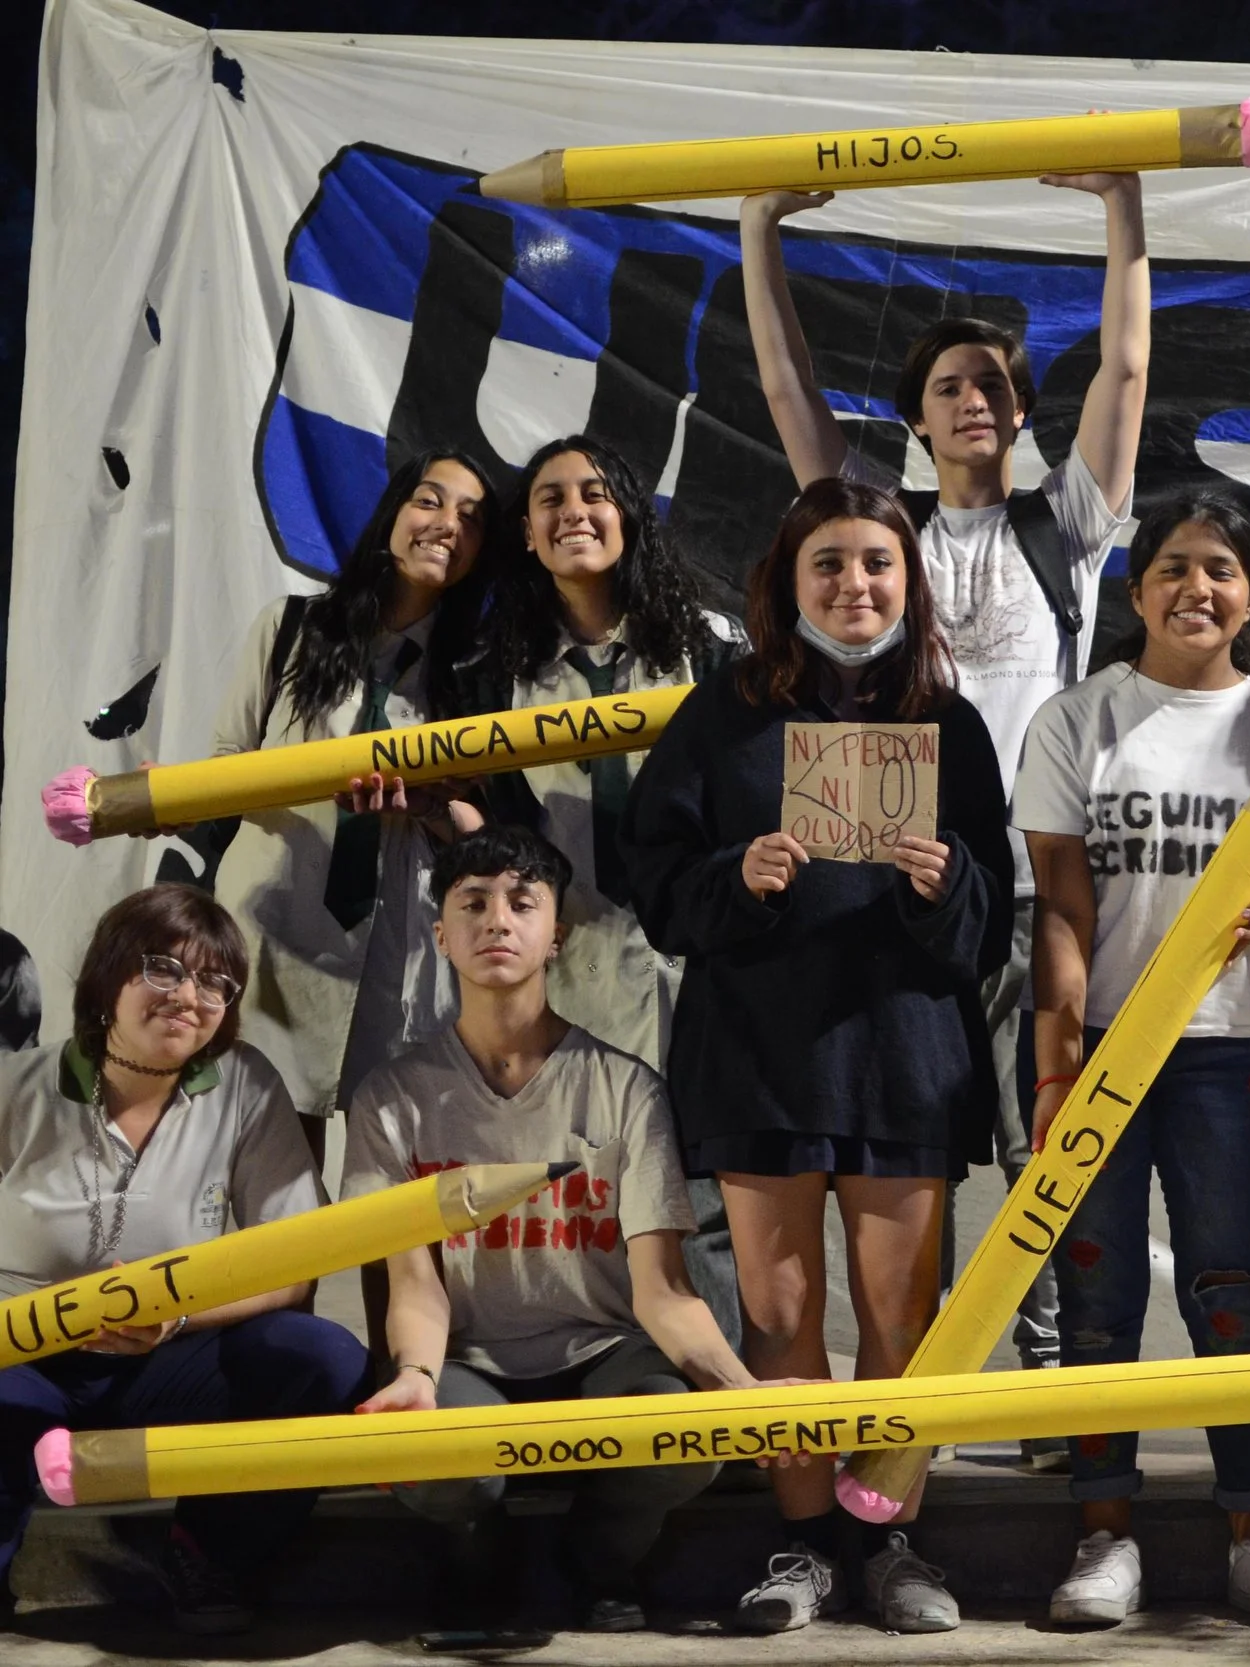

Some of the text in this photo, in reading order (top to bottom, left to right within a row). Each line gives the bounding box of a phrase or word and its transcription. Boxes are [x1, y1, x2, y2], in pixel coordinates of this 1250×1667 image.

[816, 133, 964, 172] H.I.J.O.S.
[965, 670, 1013, 681] ALMOND
[372, 701, 647, 772] NUNCA MAS
[792, 729, 824, 764] NI
[821, 775, 852, 813] NI
[1008, 1069, 1144, 1256] U.E.S.T.
[6, 1255, 195, 1353] U.E.S.T.
[494, 1413, 917, 1468] 30.000 PRESENTES
